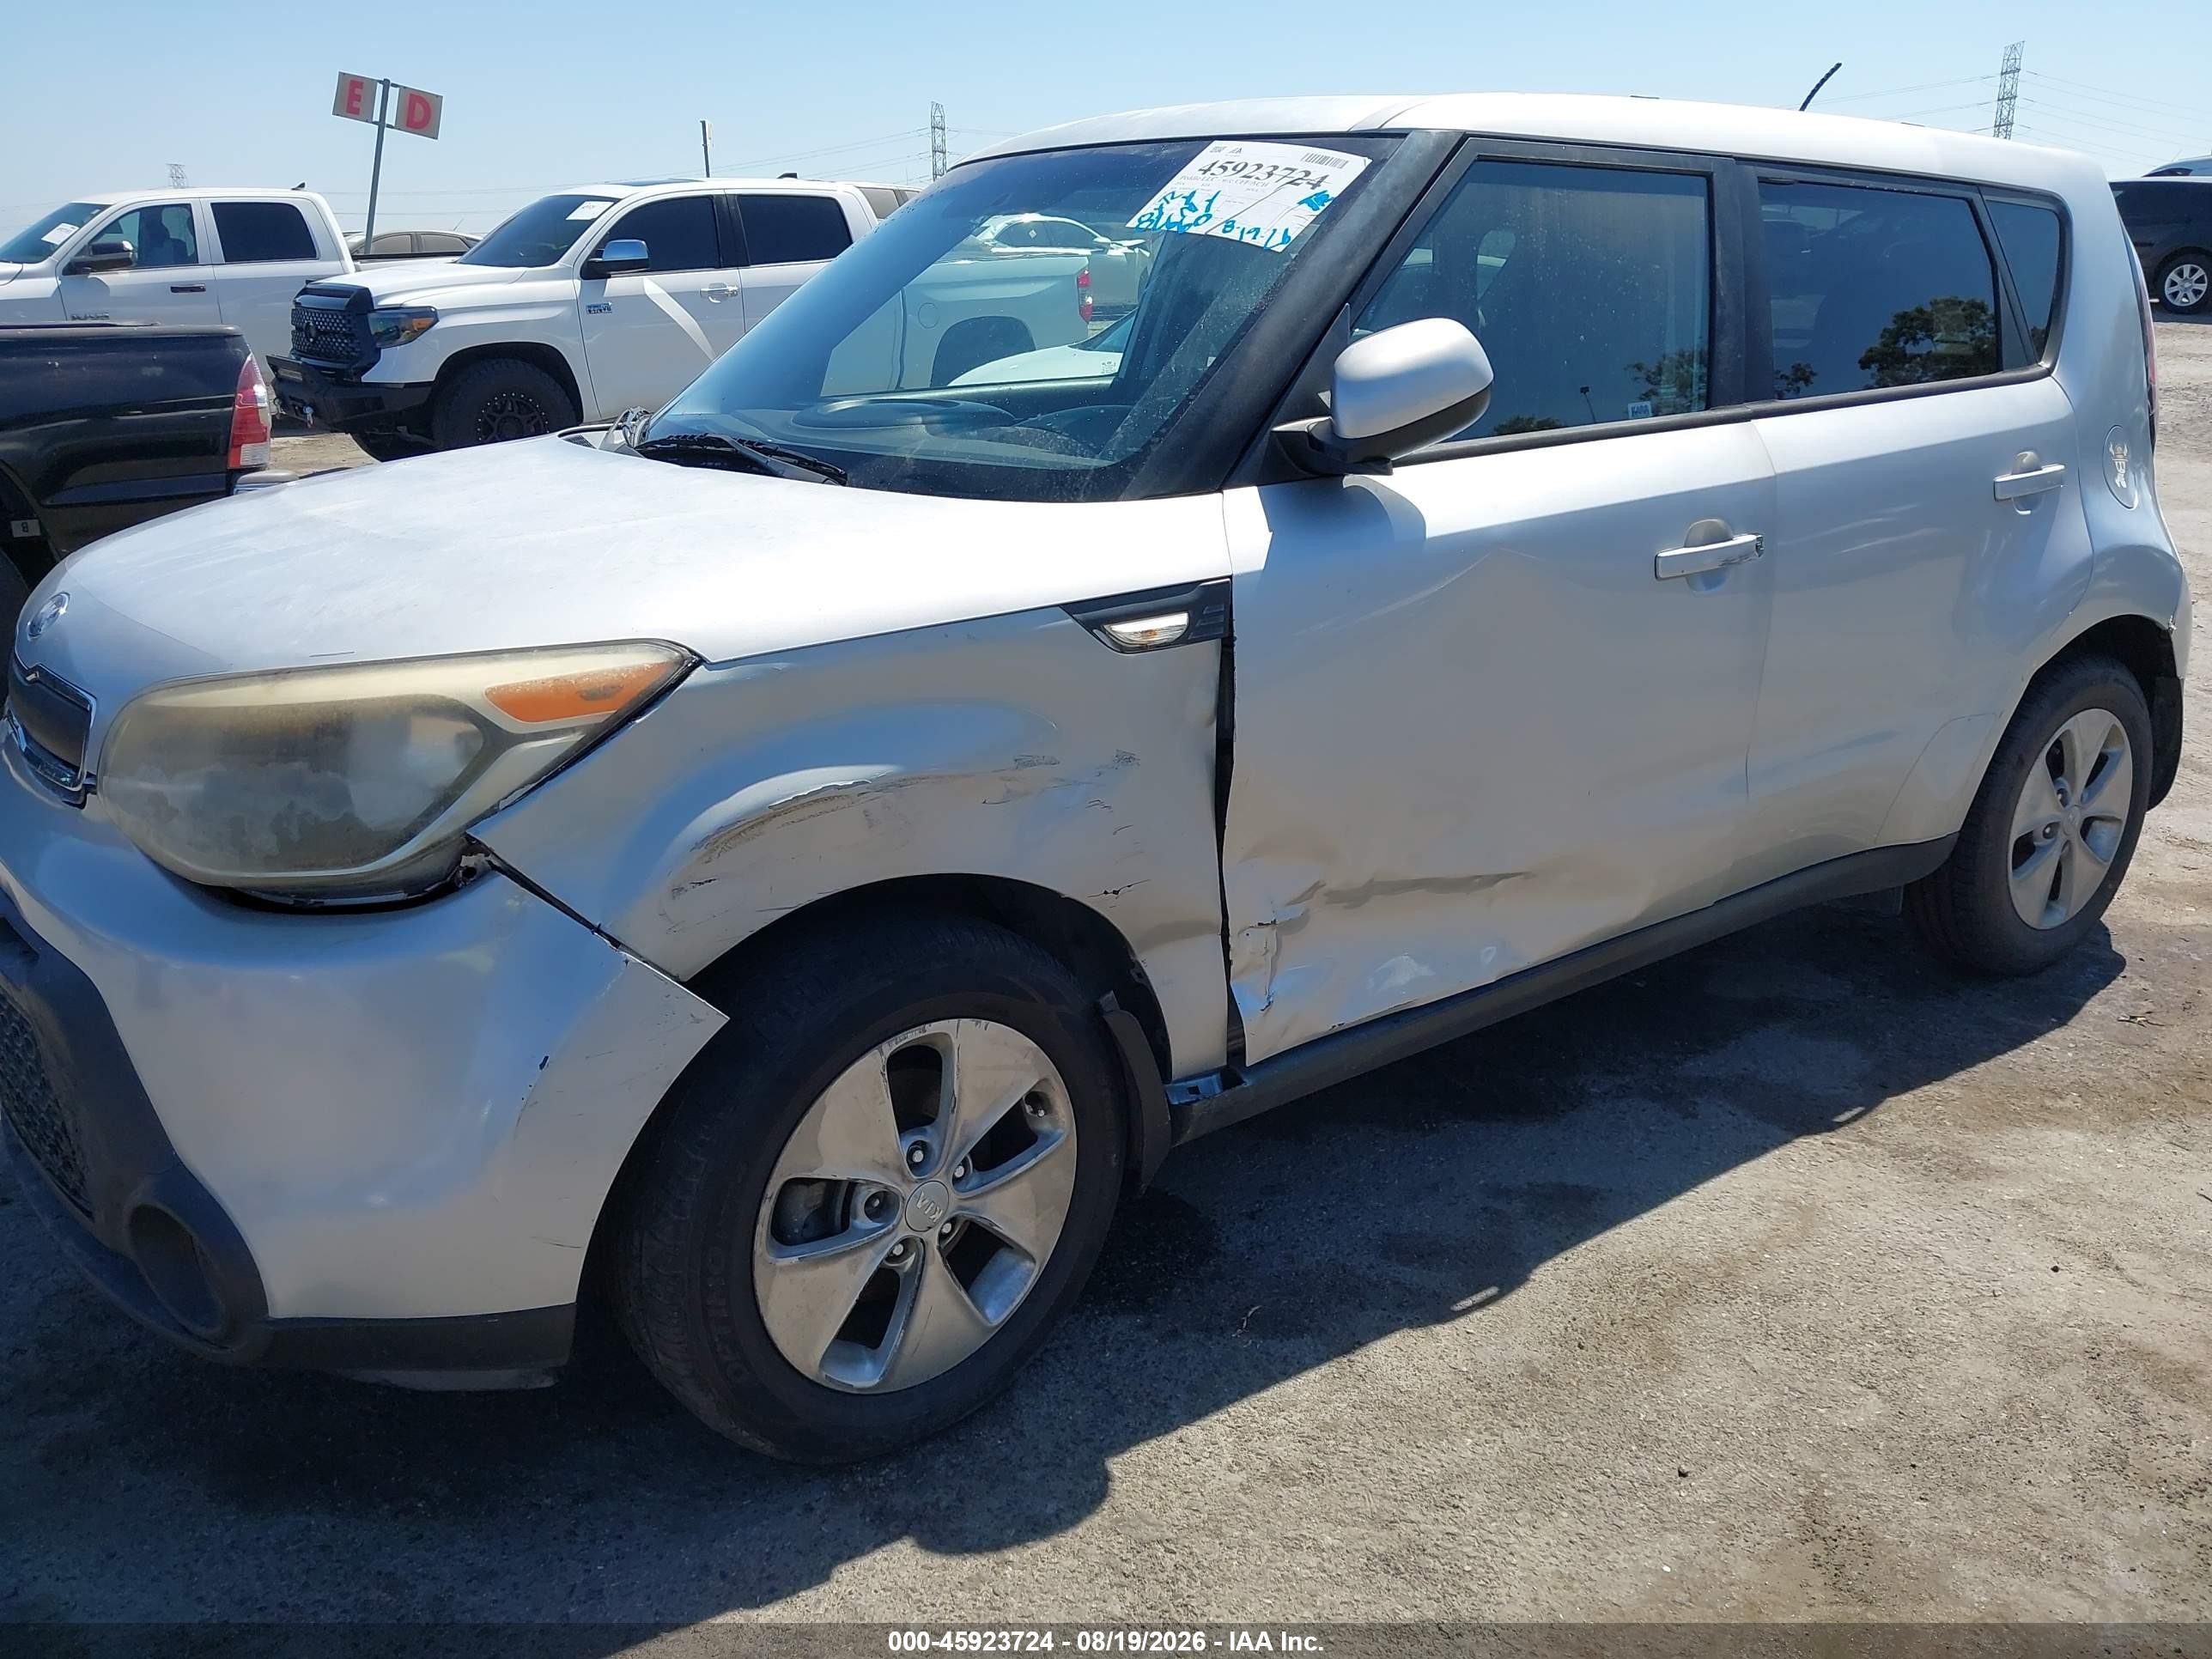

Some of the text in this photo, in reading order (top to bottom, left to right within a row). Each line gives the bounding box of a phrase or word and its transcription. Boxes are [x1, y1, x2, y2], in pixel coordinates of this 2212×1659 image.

[346, 80, 365, 116] E
[406, 93, 432, 130] D
[1198, 160, 1329, 190] 45923724
[916, 1190, 943, 1223] KIA
